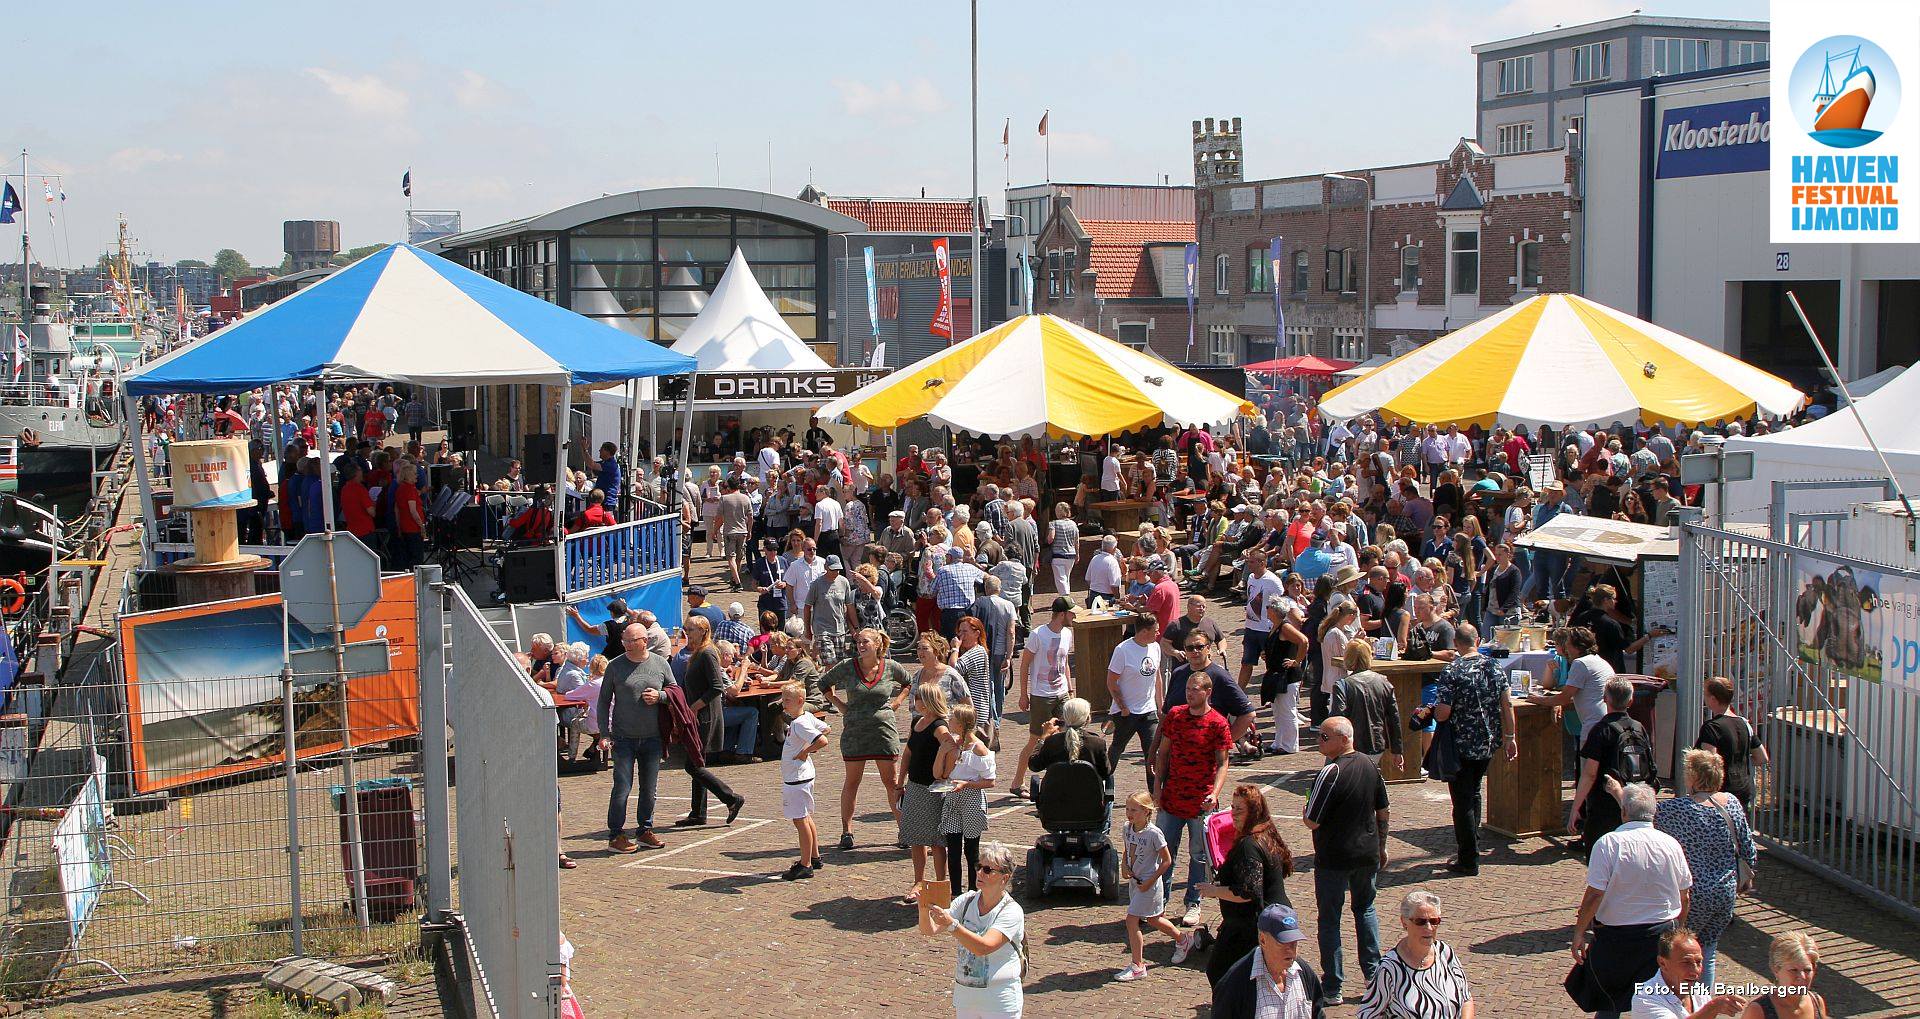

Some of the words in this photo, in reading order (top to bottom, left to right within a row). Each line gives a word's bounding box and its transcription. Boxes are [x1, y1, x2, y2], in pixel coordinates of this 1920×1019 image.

[1664, 112, 1770, 152] Kloosterbo
[876, 261, 930, 280] TOMATERIALEN
[950, 258, 972, 277] NDEN
[1777, 254, 1789, 270] 28
[714, 376, 836, 396] DRINKS
[184, 461, 228, 473] CULINAIR
[191, 472, 220, 483] PLEIN
[1871, 594, 1890, 609] hoe
[1892, 600, 1912, 619] vang
